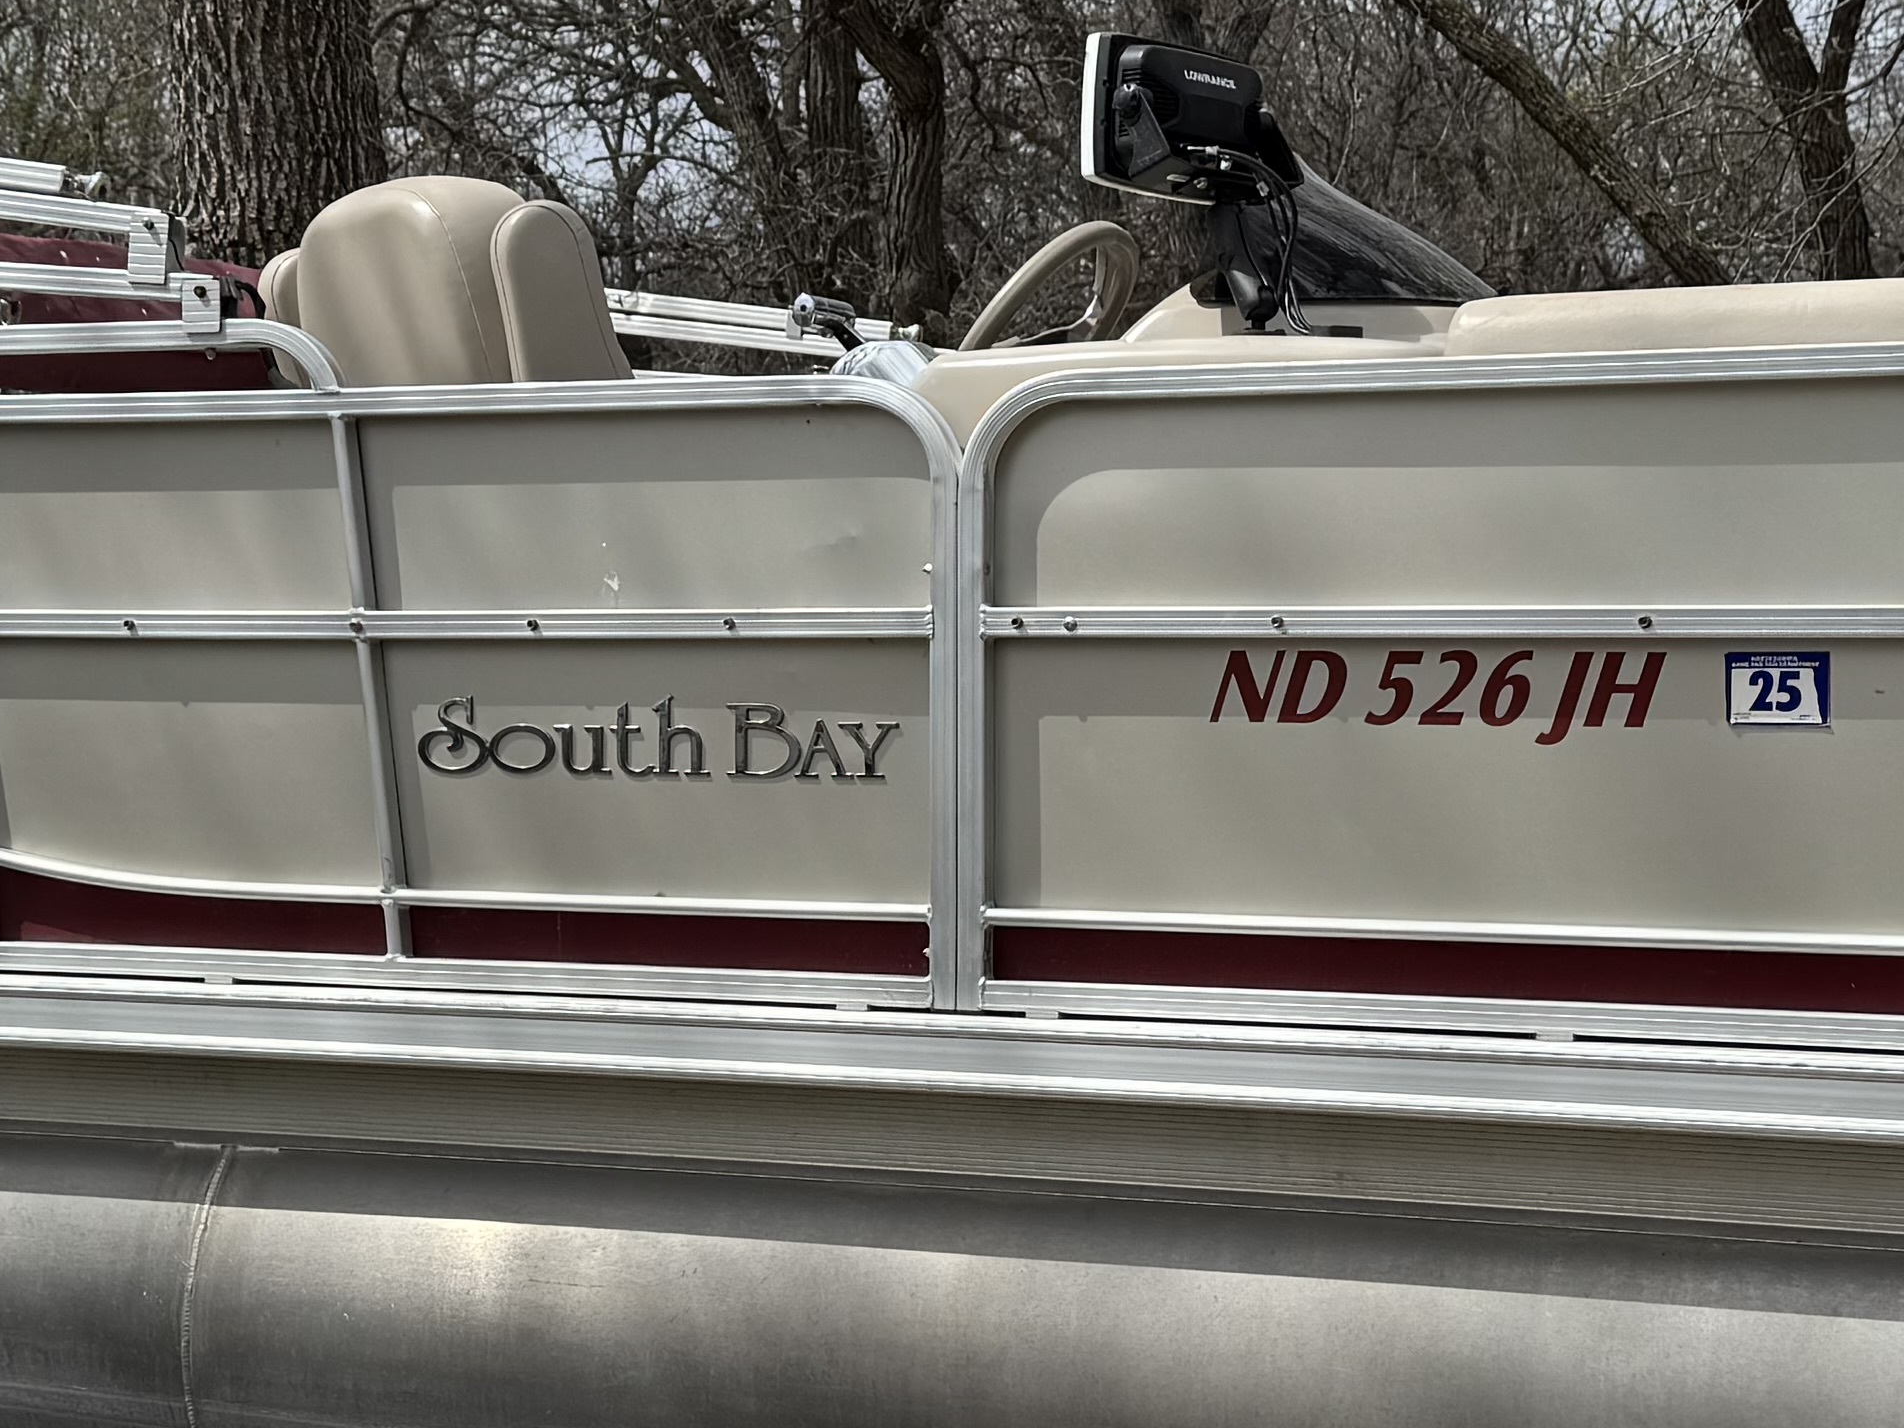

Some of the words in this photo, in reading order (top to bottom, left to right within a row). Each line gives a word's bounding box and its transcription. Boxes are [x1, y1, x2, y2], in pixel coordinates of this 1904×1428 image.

[1208, 649, 1348, 724] ND
[1363, 649, 1535, 726] 526
[1533, 650, 1667, 746] JH
[1748, 669, 1803, 713] 25
[416, 692, 712, 779] South
[725, 701, 900, 780] BAY
